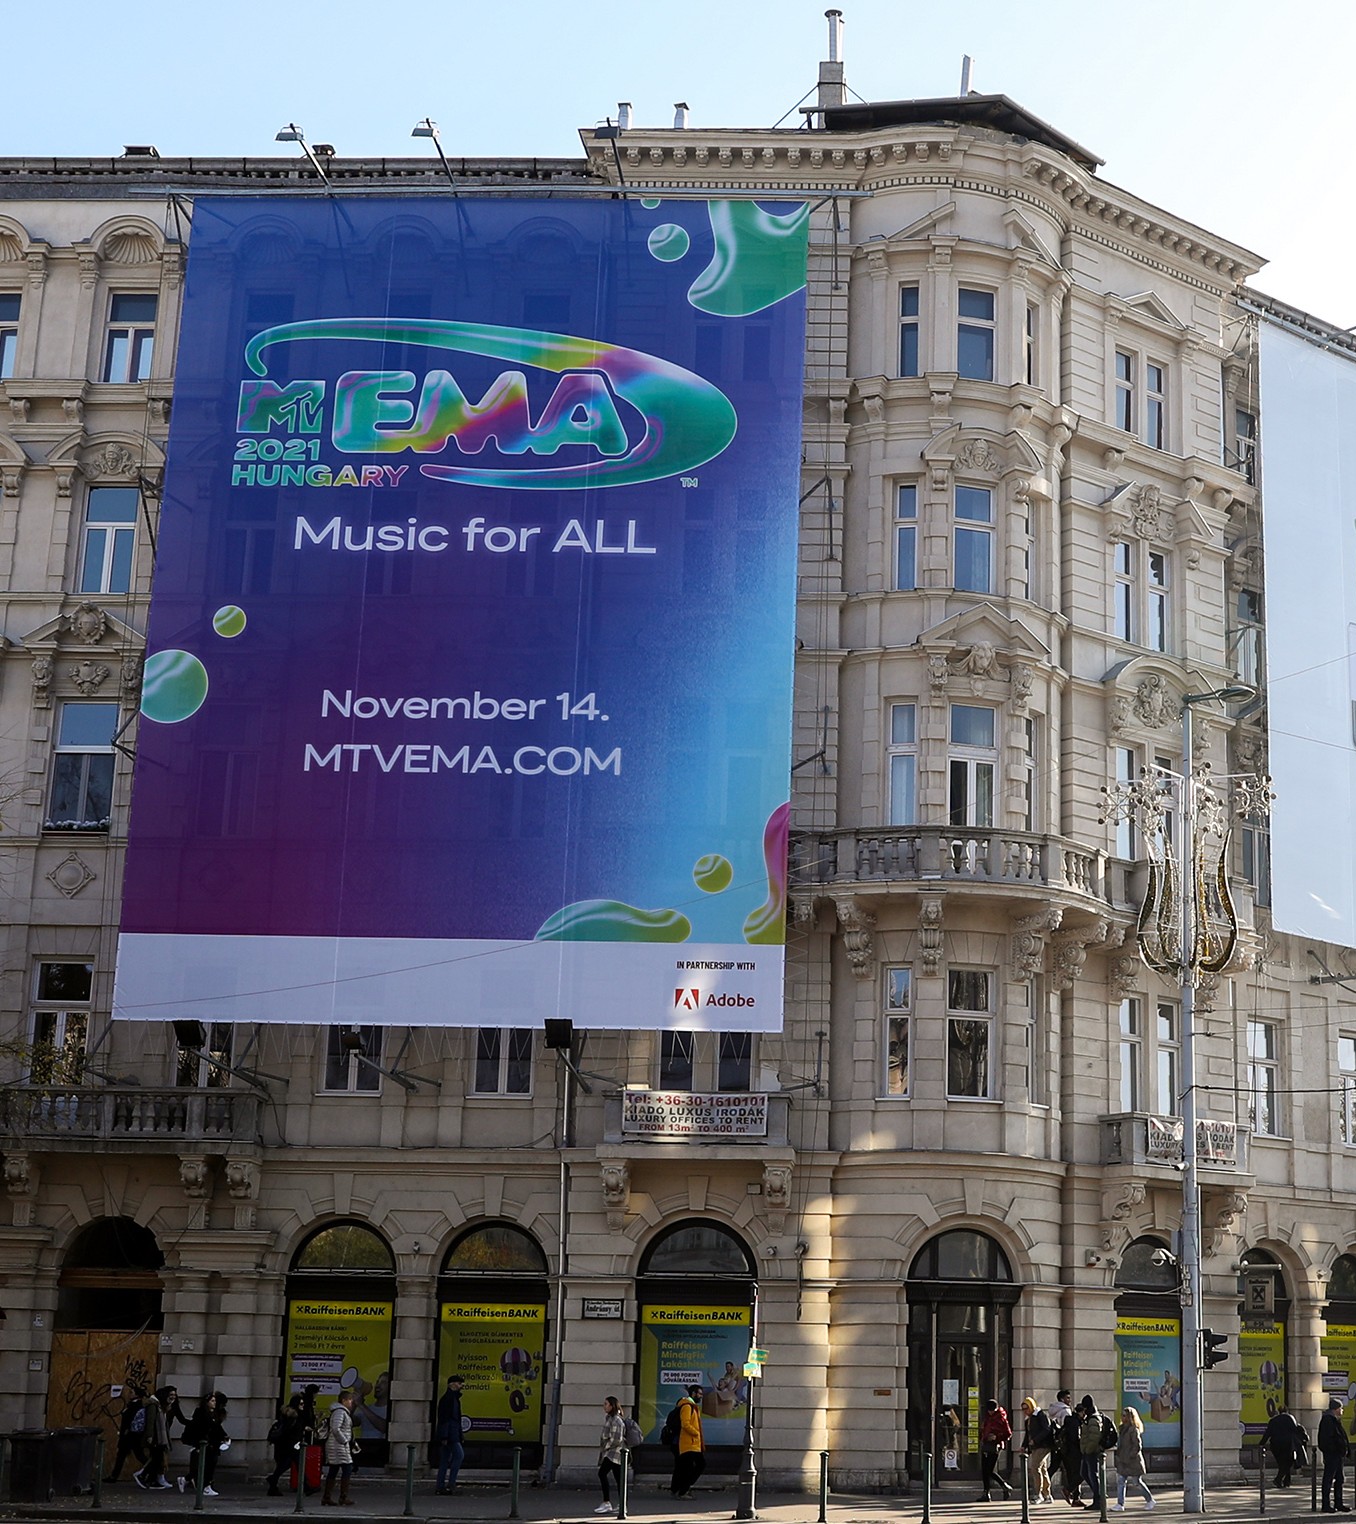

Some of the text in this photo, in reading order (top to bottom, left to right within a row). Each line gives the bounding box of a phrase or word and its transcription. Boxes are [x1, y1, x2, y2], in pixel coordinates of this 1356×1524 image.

[331, 368, 629, 455] EMA
[234, 438, 321, 462] 2021
[231, 464, 410, 487] HUNGARY
[293, 516, 657, 555] Music for ALL
[320, 689, 610, 721] November 14.
[303, 743, 622, 776] MTVEMA.COM
[676, 961, 755, 971] IN PARTNERSHIP WITH
[706, 991, 755, 1008] Adobe
[626, 1093, 766, 1107] Tel: +36-30-1610101
[625, 1105, 765, 1117] KIADÓ LUXUS IRODÁK
[625, 1115, 764, 1125] LUXURY OFFICES TO RENT
[713, 1125, 733, 1133] 400
[304, 1305, 386, 1316] RaiffeisenBANK
[456, 1307, 539, 1318] RaiffeisenBANK
[659, 1310, 743, 1321] RaiffeisenBANK
[1122, 1322, 1175, 1333] RaiffeisenBANK
[295, 1334, 323, 1342] Személyi
[661, 1341, 708, 1350] Raiffeisen
[458, 1354, 488, 1362] Nyisson
[457, 1363, 496, 1371] Raiffeisen
